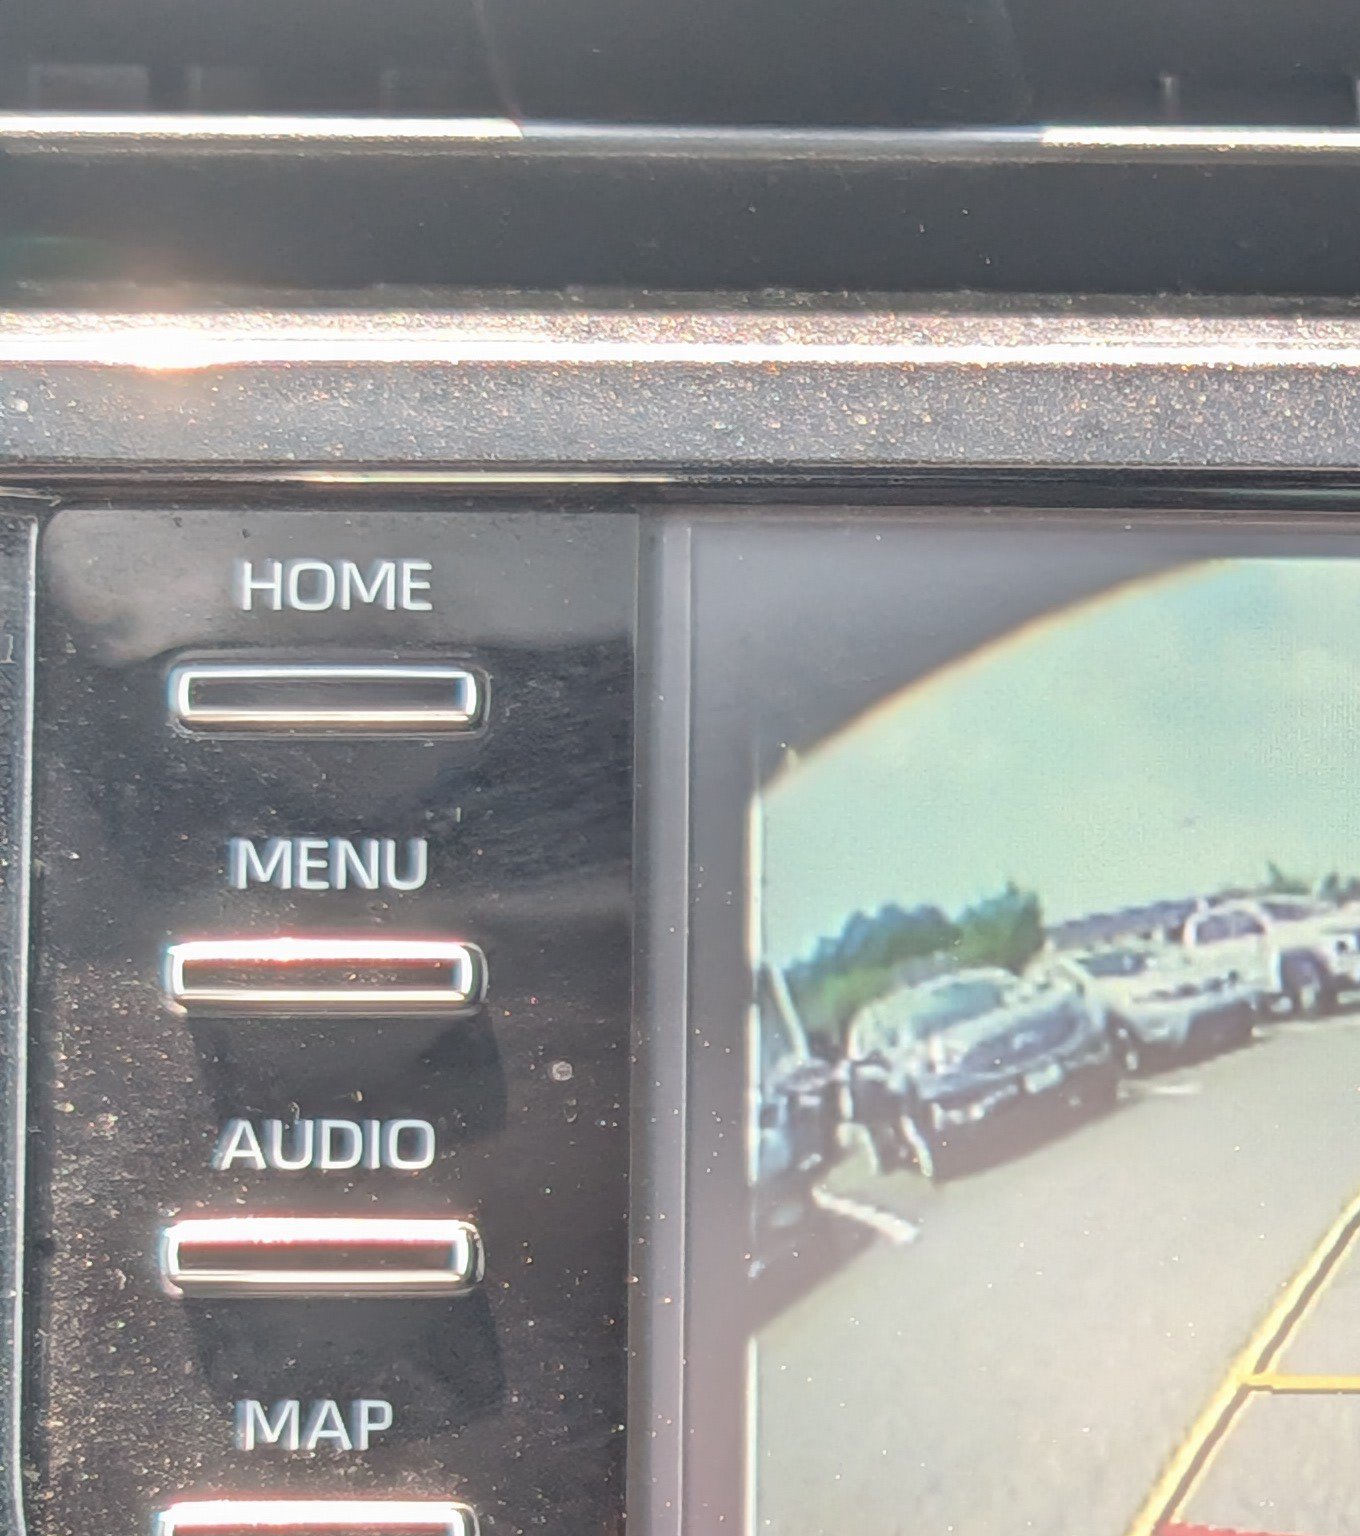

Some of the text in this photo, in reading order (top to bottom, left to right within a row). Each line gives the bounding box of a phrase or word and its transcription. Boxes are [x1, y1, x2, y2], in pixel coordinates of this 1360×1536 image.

[239, 558, 434, 614] HOME
[232, 836, 428, 891] MENU
[216, 1117, 436, 1171] AUDIO
[238, 1399, 394, 1451] MAP
